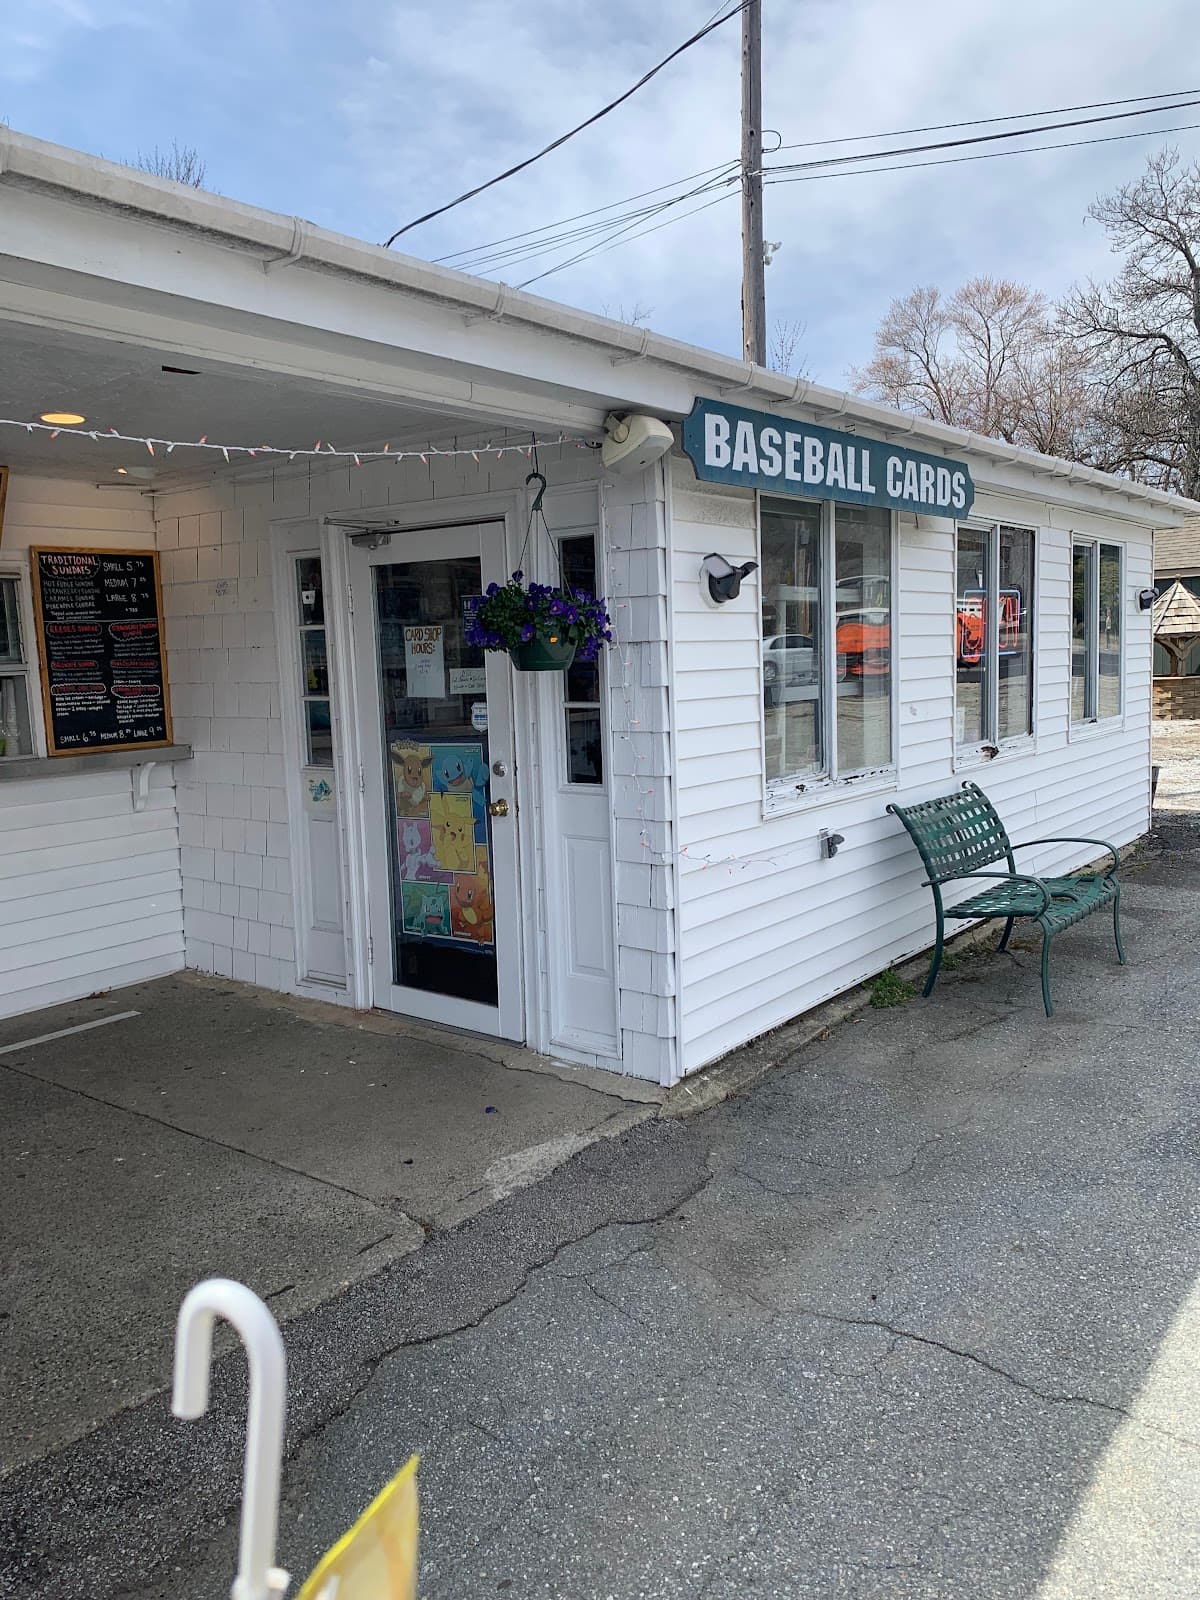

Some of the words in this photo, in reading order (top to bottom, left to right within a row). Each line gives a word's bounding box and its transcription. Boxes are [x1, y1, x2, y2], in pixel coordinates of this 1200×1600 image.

[704, 413, 876, 494] BASEBALL
[886, 456, 966, 509] CARDS
[40, 555, 98, 565] TRADITIONAL
[405, 628, 423, 641] CARD
[424, 627, 442, 641] SHOP
